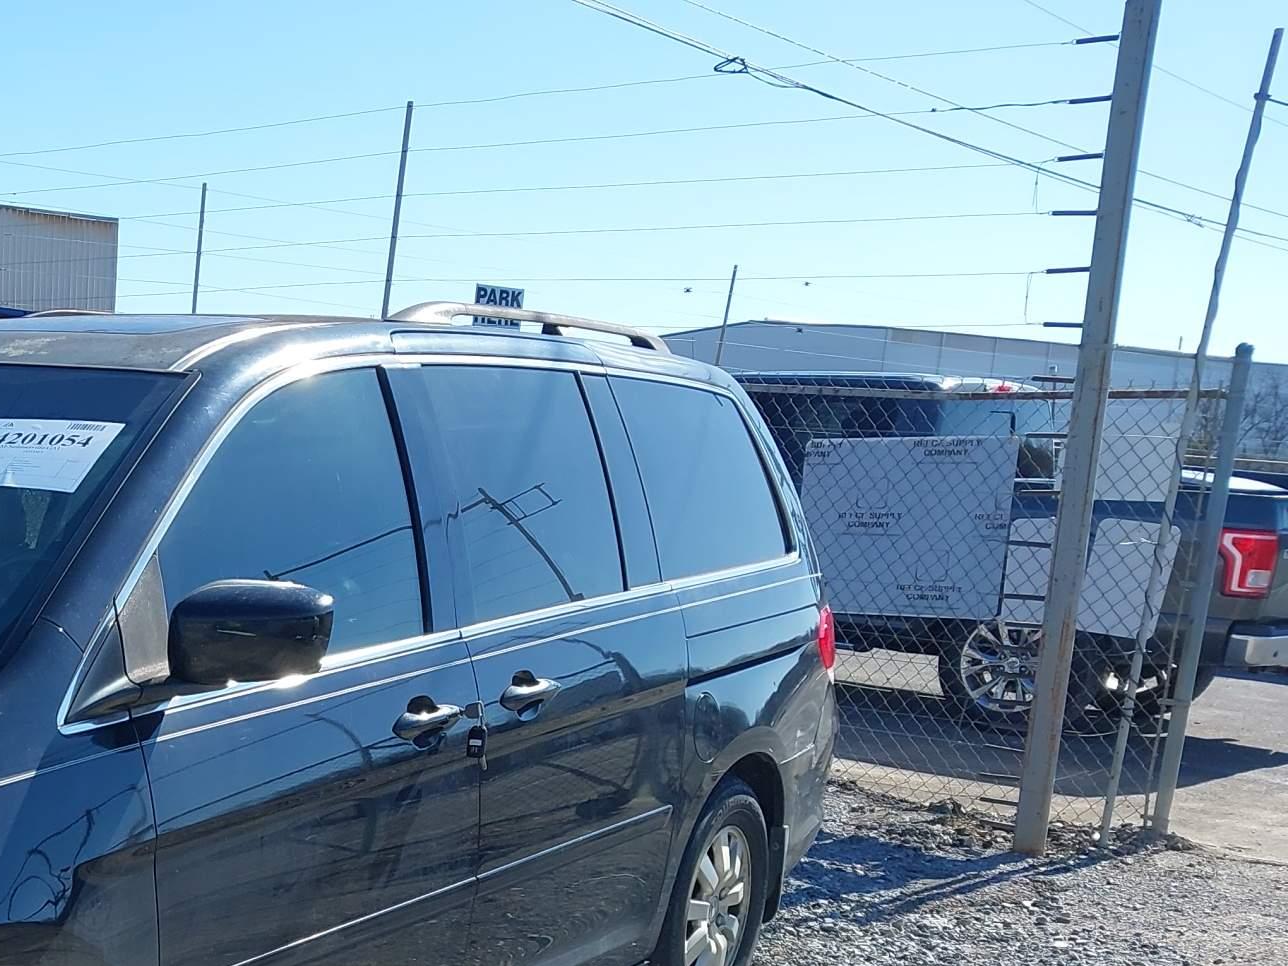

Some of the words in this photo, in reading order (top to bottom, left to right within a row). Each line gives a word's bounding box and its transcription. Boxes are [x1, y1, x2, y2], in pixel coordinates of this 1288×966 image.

[476, 287, 523, 308] PARK
[923, 448, 969, 457] COMPANY
[848, 520, 890, 529] COMPANY
